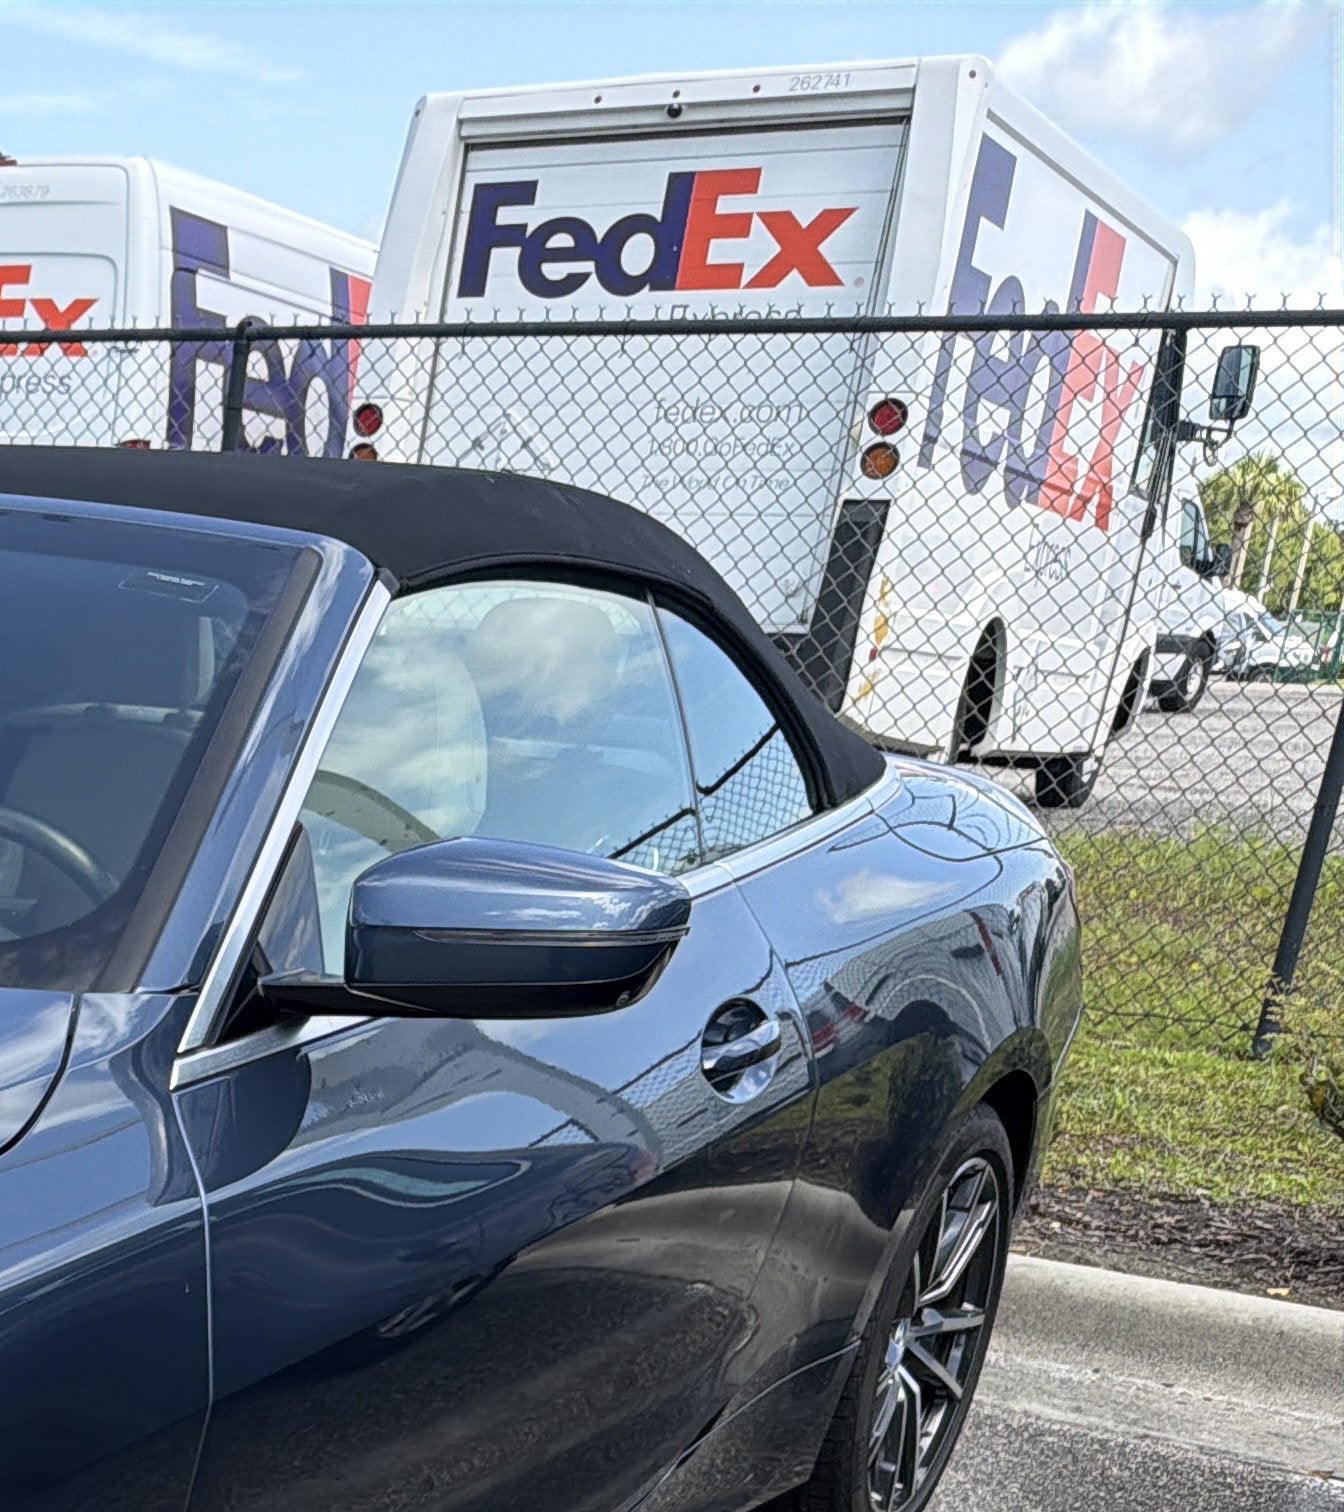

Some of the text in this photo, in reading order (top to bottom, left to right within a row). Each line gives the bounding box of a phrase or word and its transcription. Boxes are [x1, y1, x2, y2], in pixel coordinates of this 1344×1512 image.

[788, 73, 851, 92] 262741
[457, 167, 859, 299] FedEx
[917, 131, 1144, 531] FedEx
